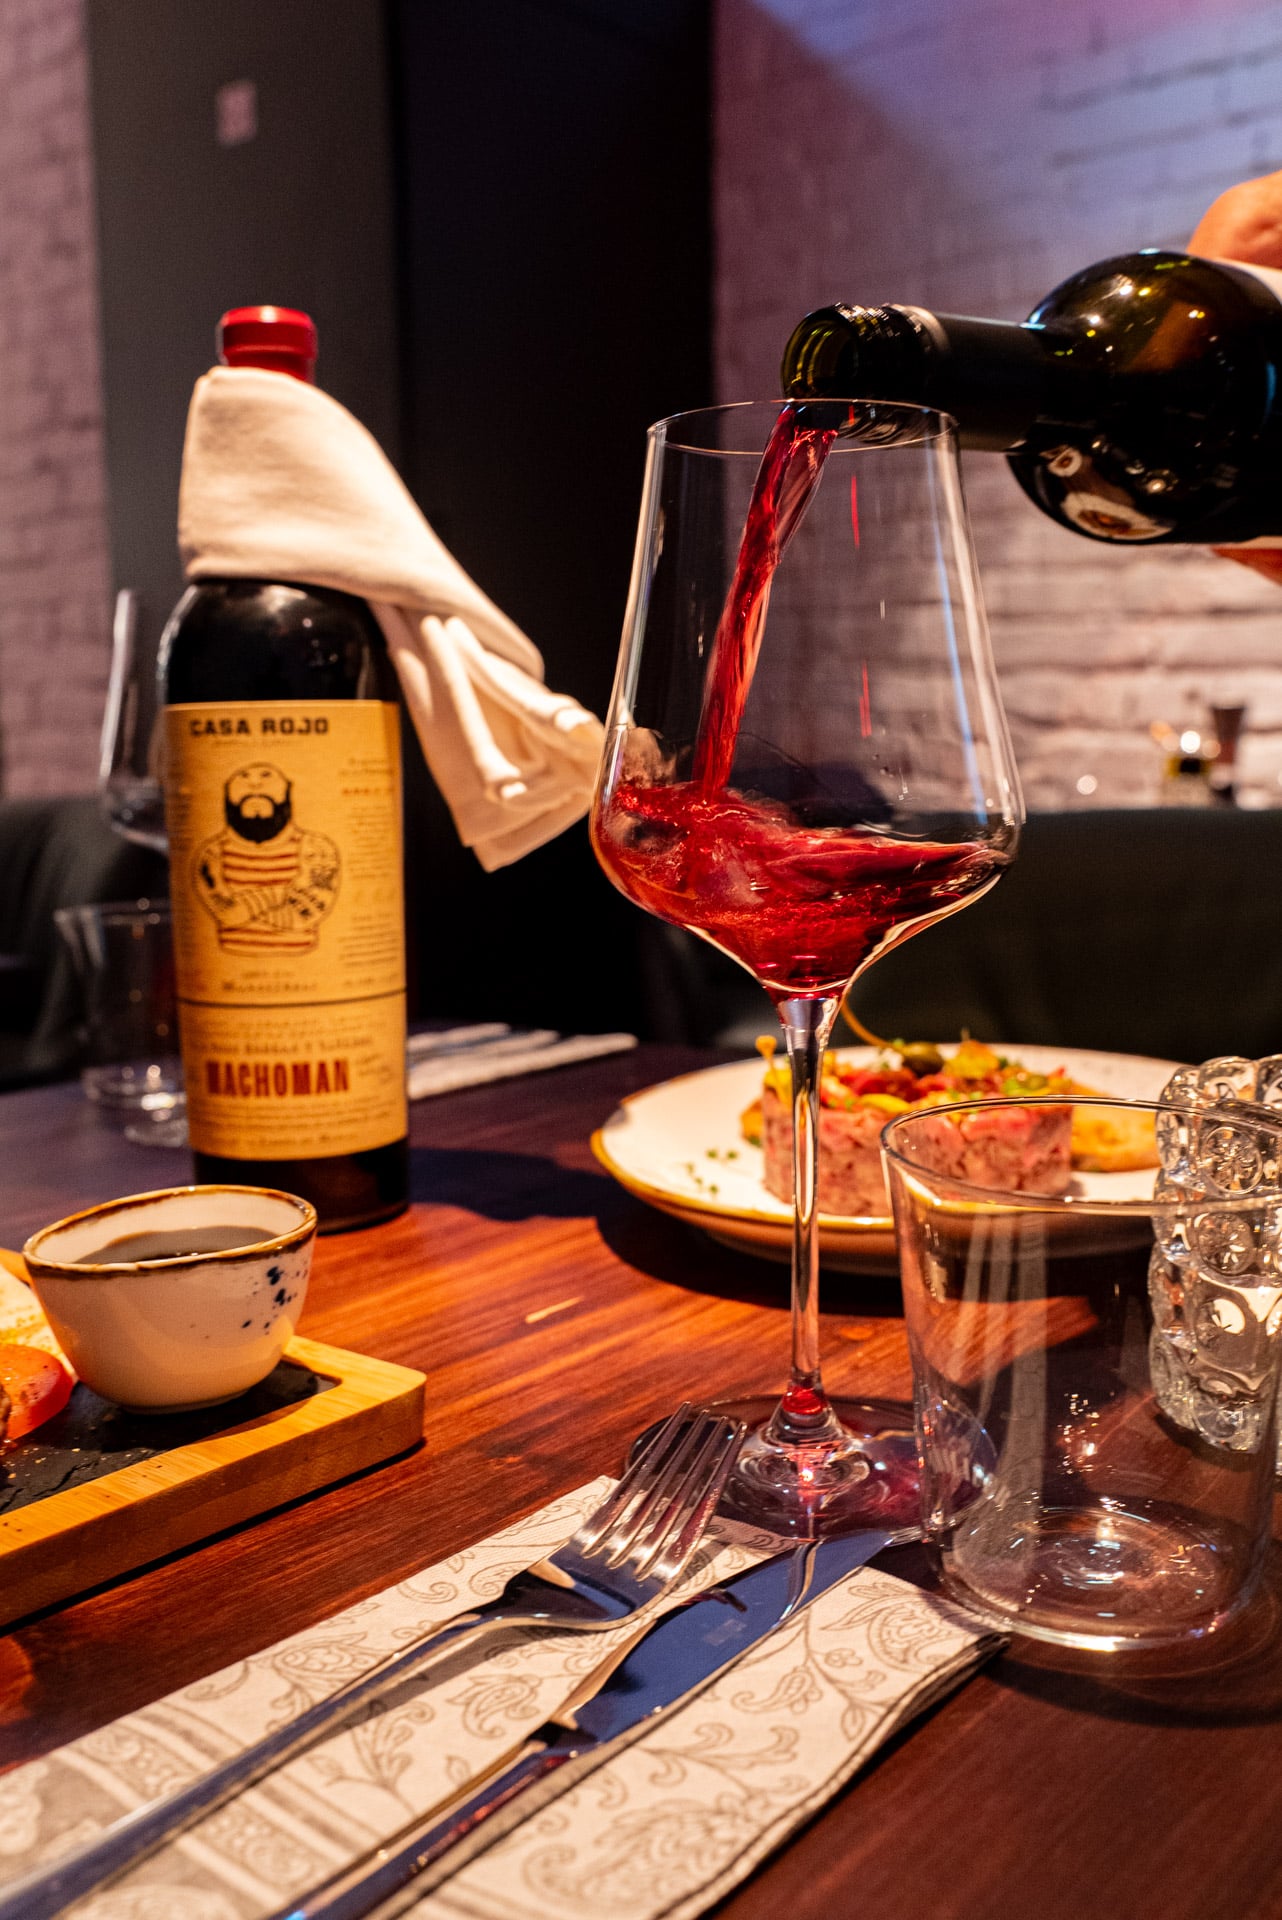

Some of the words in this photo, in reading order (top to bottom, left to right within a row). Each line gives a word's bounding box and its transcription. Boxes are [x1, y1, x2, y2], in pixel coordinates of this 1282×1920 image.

[190, 718, 251, 736] CASA
[261, 717, 329, 735] ROJO
[206, 1059, 349, 1096] MACHOMAN
